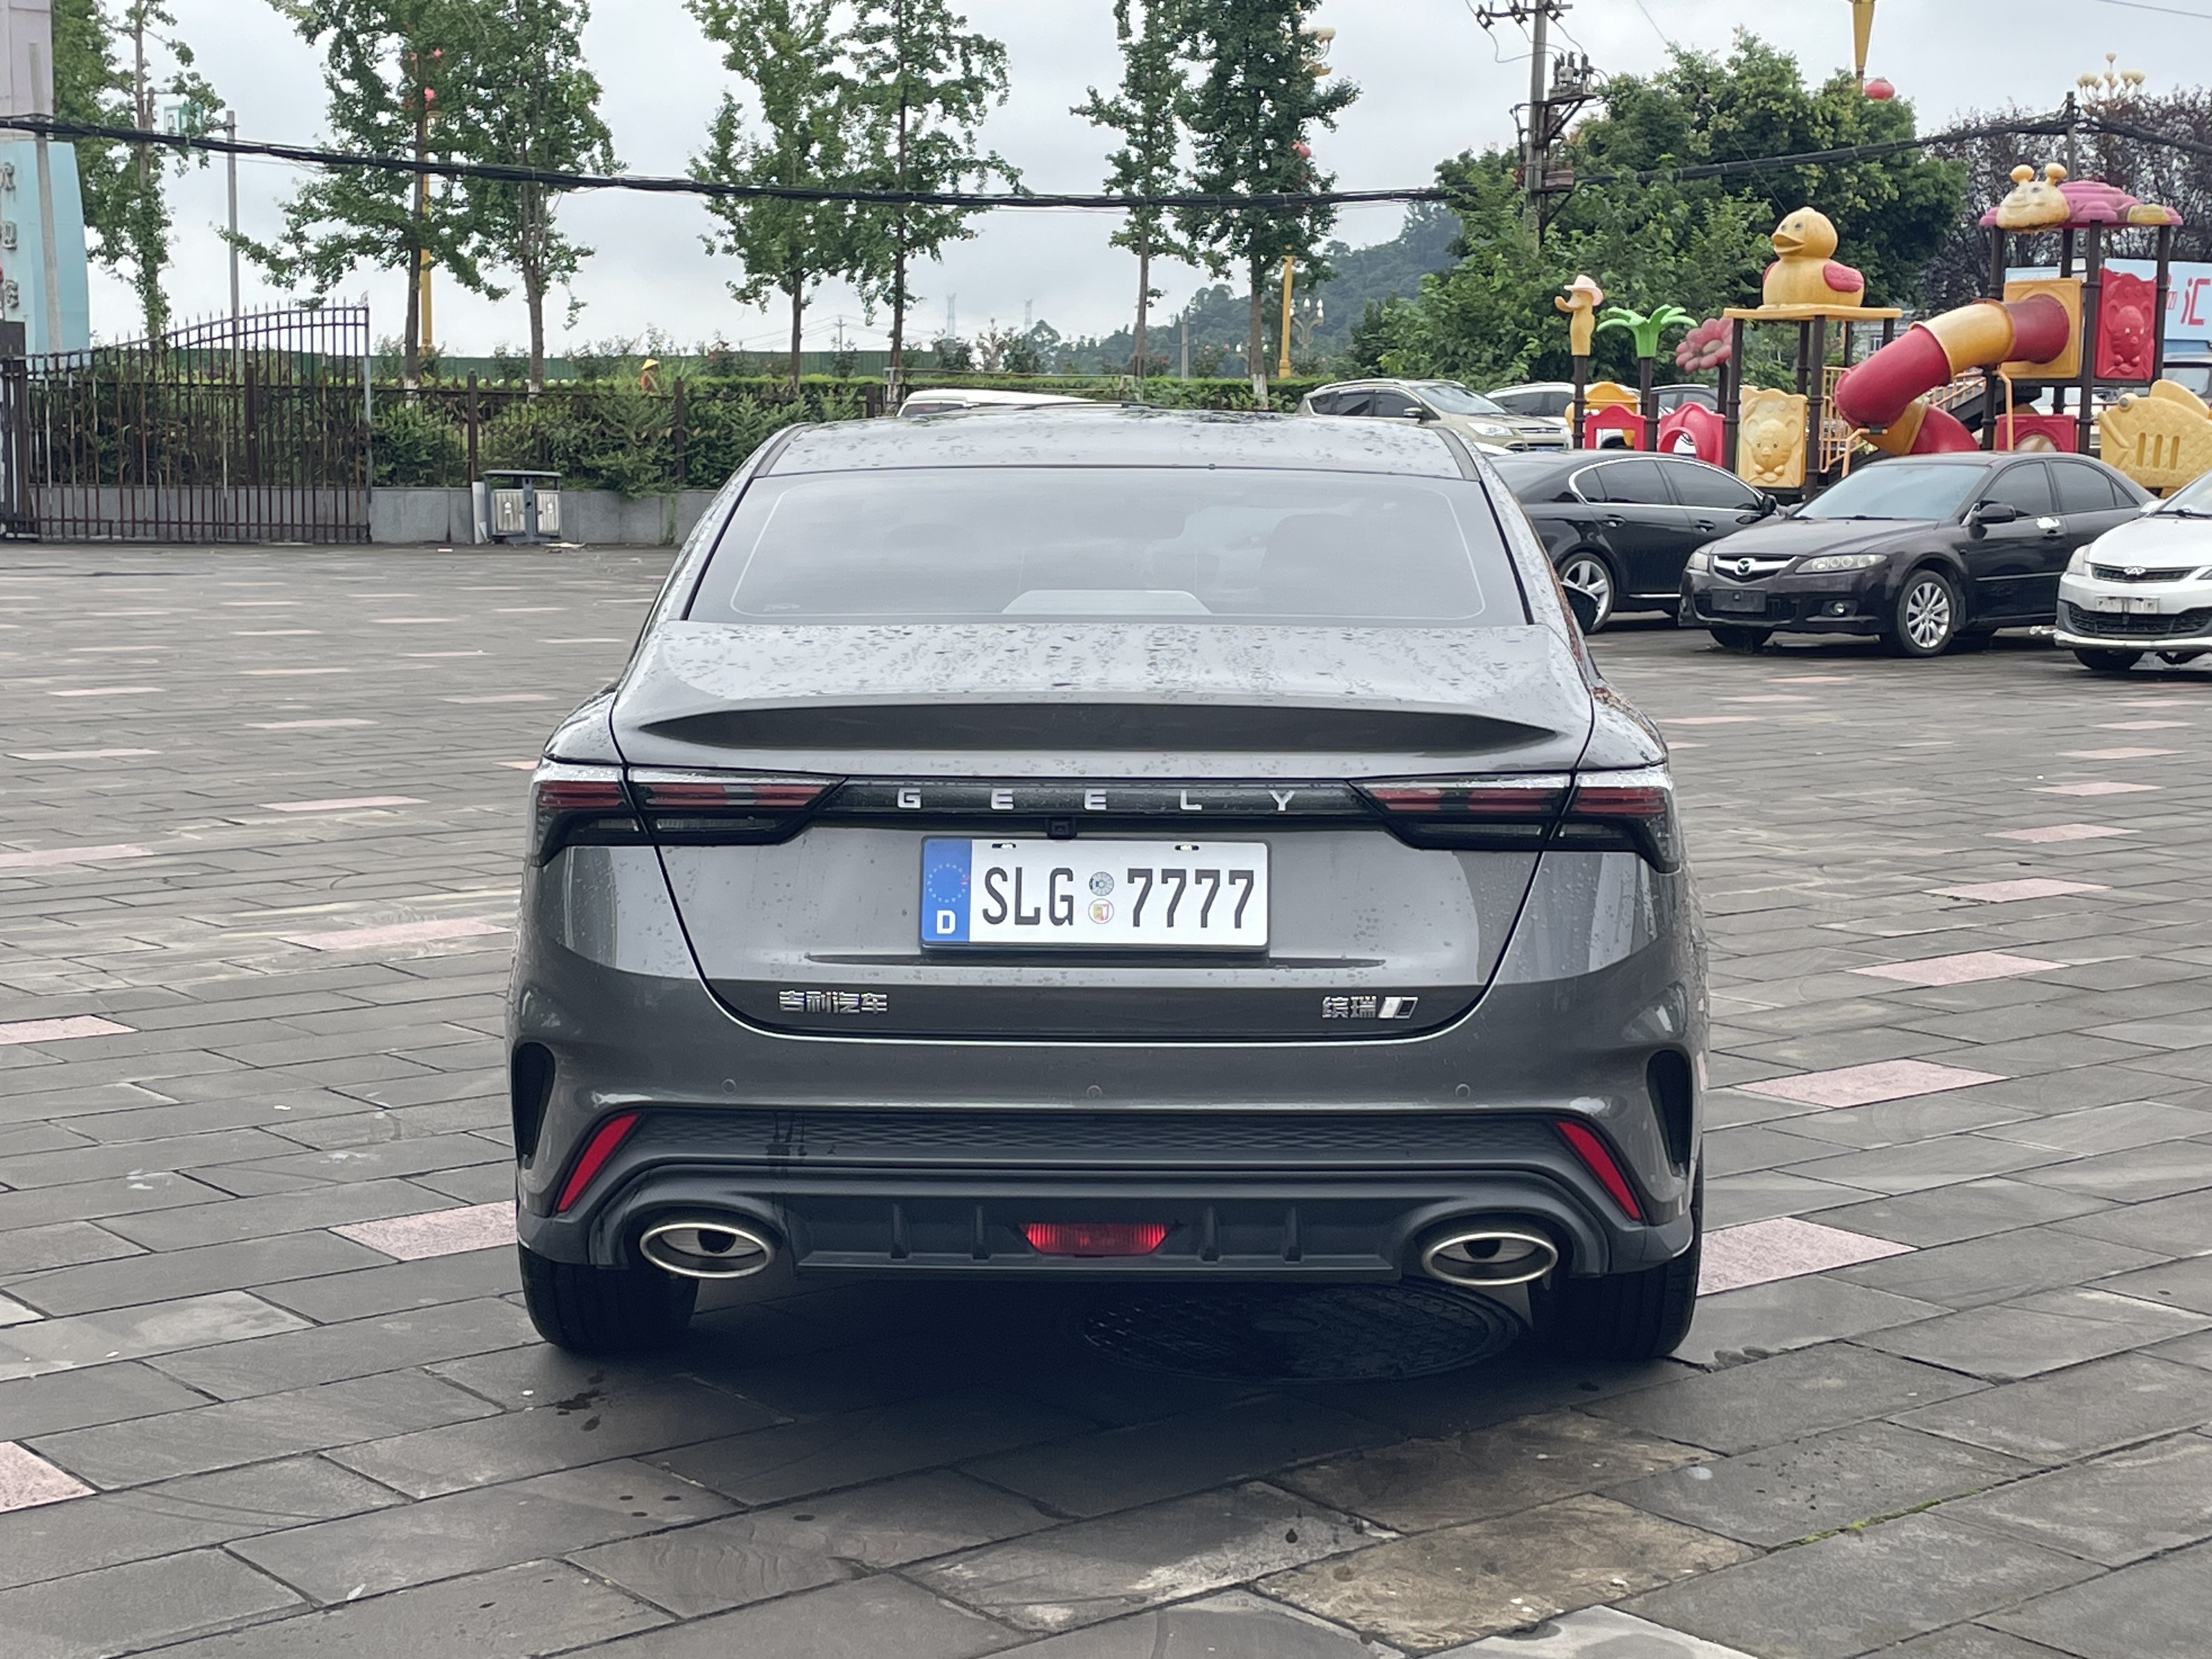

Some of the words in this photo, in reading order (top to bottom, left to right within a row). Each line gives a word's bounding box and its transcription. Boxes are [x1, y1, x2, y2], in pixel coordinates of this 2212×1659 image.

[897, 787, 1295, 811] GEELY
[982, 867, 1074, 926] SLG
[1127, 868, 1255, 929] 7777
[936, 910, 956, 934] D
[779, 990, 888, 1013] 吉利汽车
[1322, 996, 1376, 1018] 缤瑞
